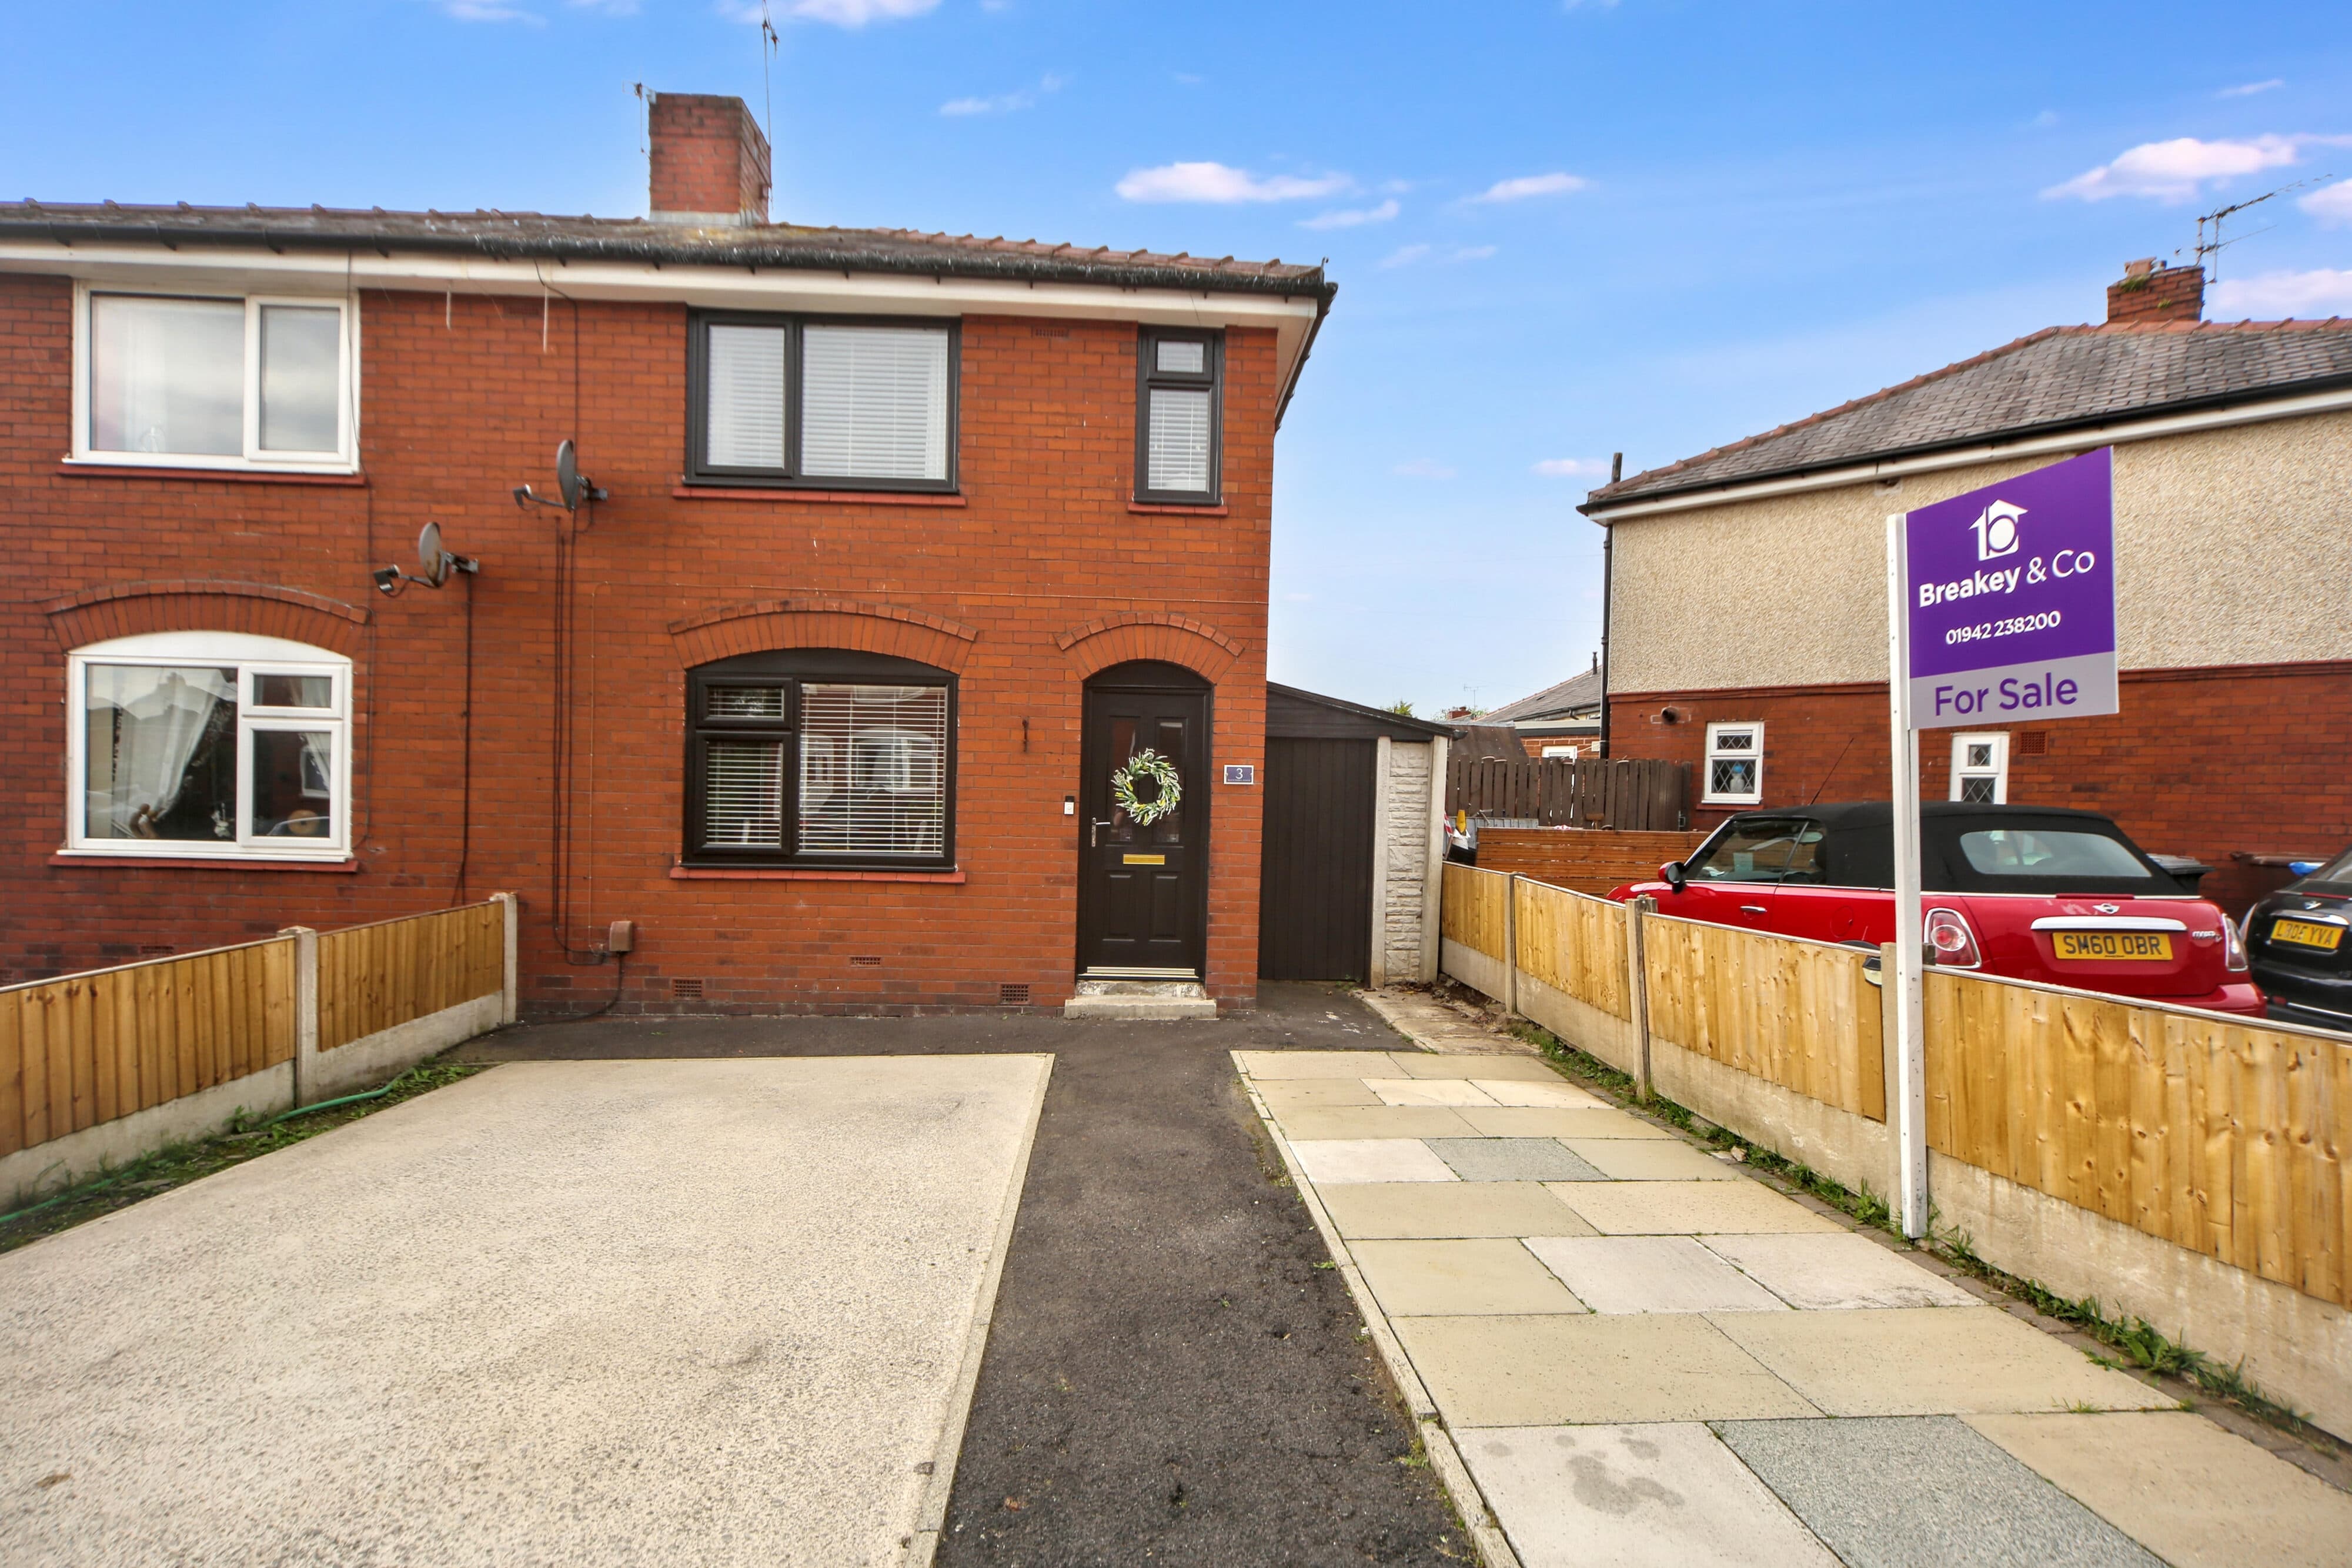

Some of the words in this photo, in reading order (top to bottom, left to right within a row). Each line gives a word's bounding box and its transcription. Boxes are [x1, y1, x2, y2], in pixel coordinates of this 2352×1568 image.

[1919, 566, 2021, 607] Breakey
[2026, 557, 2047, 584] &
[2052, 550, 2095, 578] Co
[1946, 623, 1992, 645] 01942
[1993, 610, 2061, 637] 238200
[1935, 685, 1989, 716] For
[1999, 672, 2078, 710] Sale
[1235, 768, 1243, 779] 3
[2063, 935, 2117, 955] SM60
[2122, 935, 2162, 955] OBR
